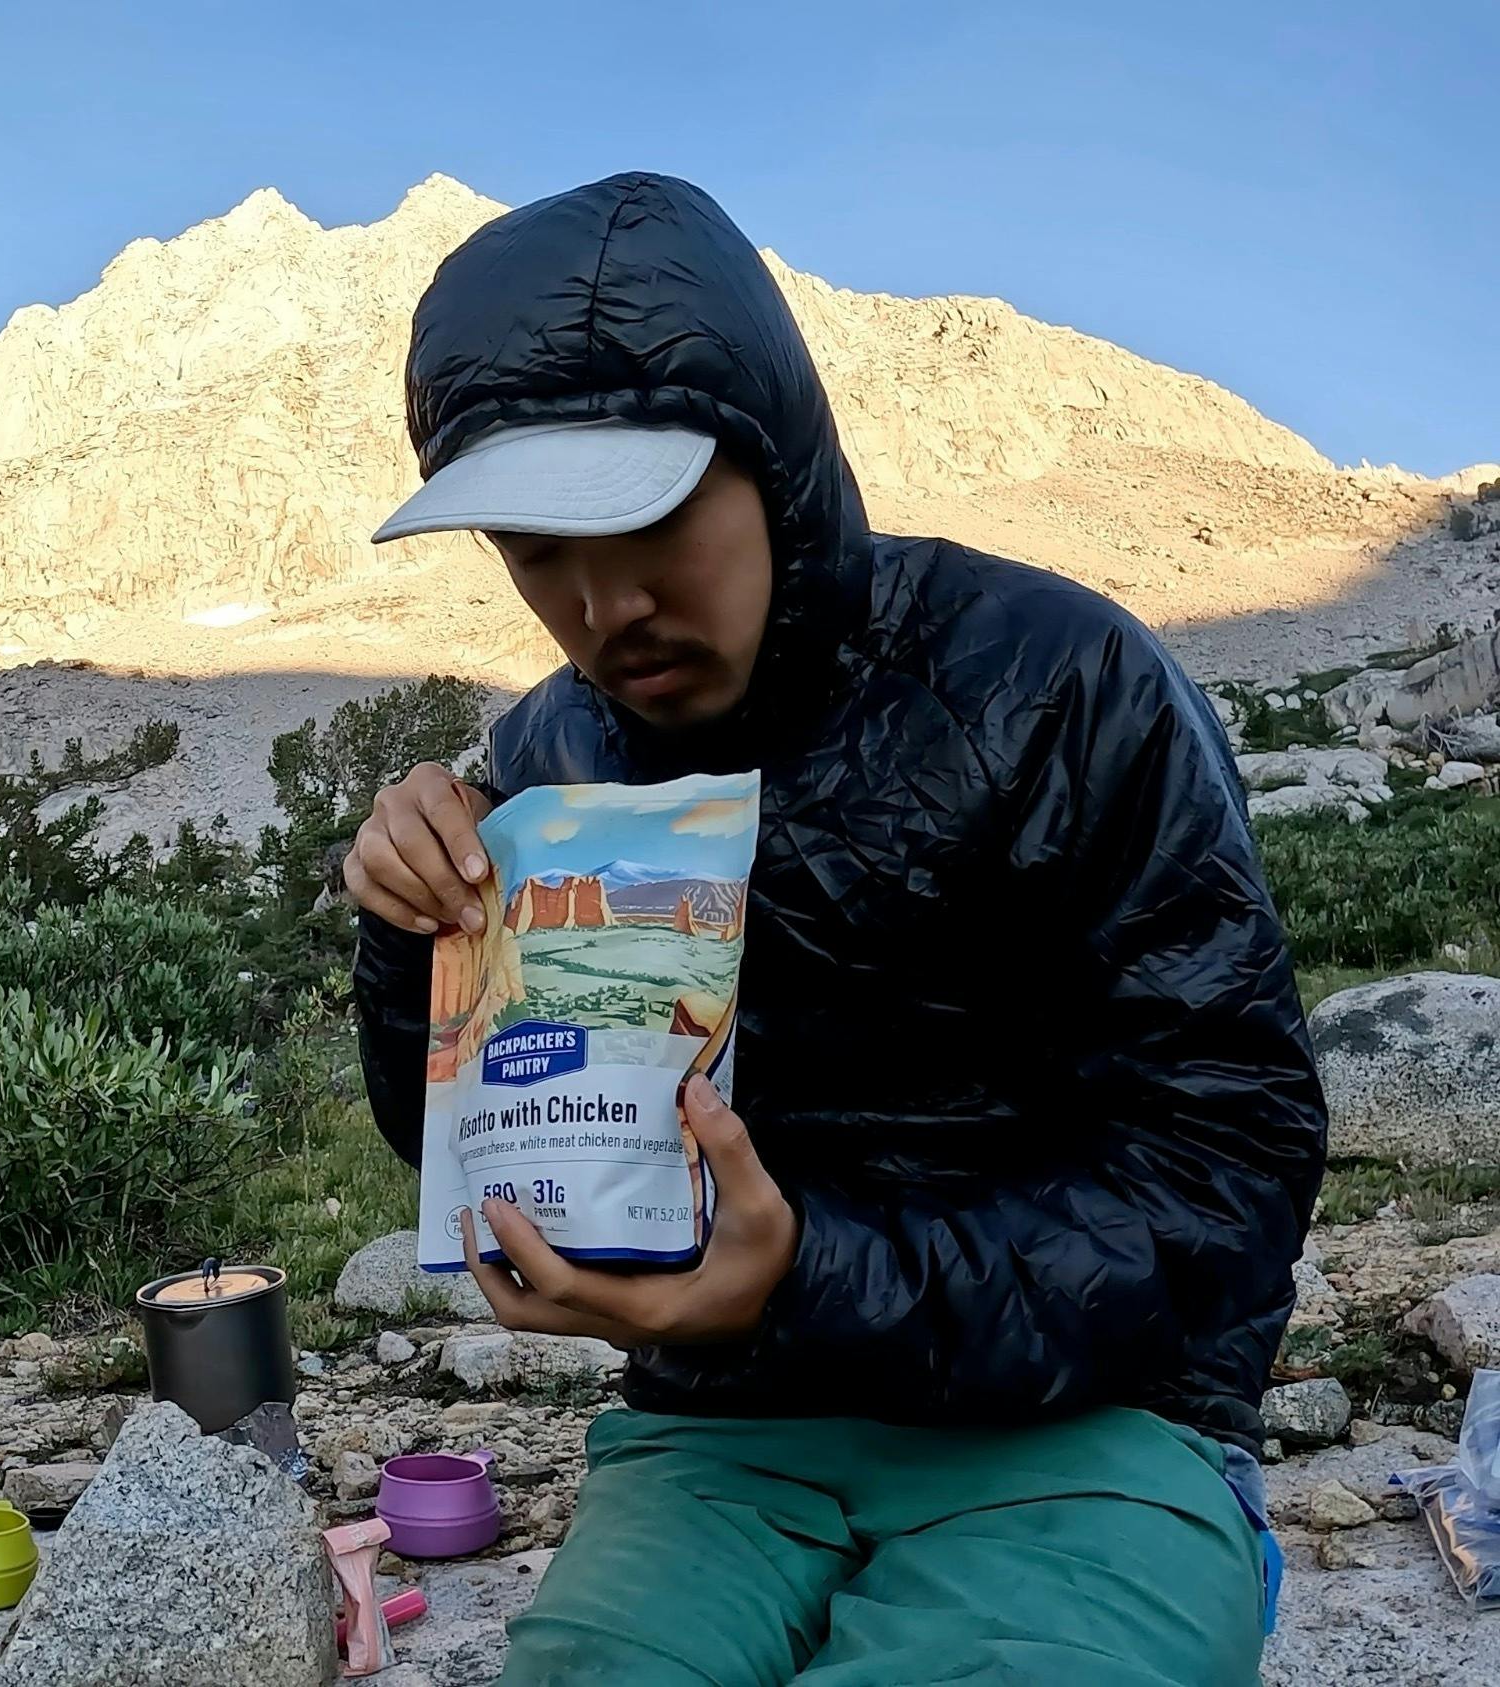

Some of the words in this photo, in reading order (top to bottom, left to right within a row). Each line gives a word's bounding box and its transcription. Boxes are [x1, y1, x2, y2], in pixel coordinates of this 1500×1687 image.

[487, 1030, 577, 1060] BACKPACKER'S
[502, 1056, 551, 1079] PANTRY
[458, 1108, 496, 1143] Risotto
[500, 1097, 541, 1130] with
[546, 1093, 638, 1124] Chicken
[519, 1135, 547, 1151] white
[549, 1134, 576, 1150] meat
[578, 1131, 621, 1148] chicken
[622, 1134, 642, 1151] and
[642, 1137, 684, 1155] vegetable
[533, 1207, 567, 1219] PROTEIN
[627, 1205, 643, 1220] NET
[660, 1207, 675, 1222] 5.2
